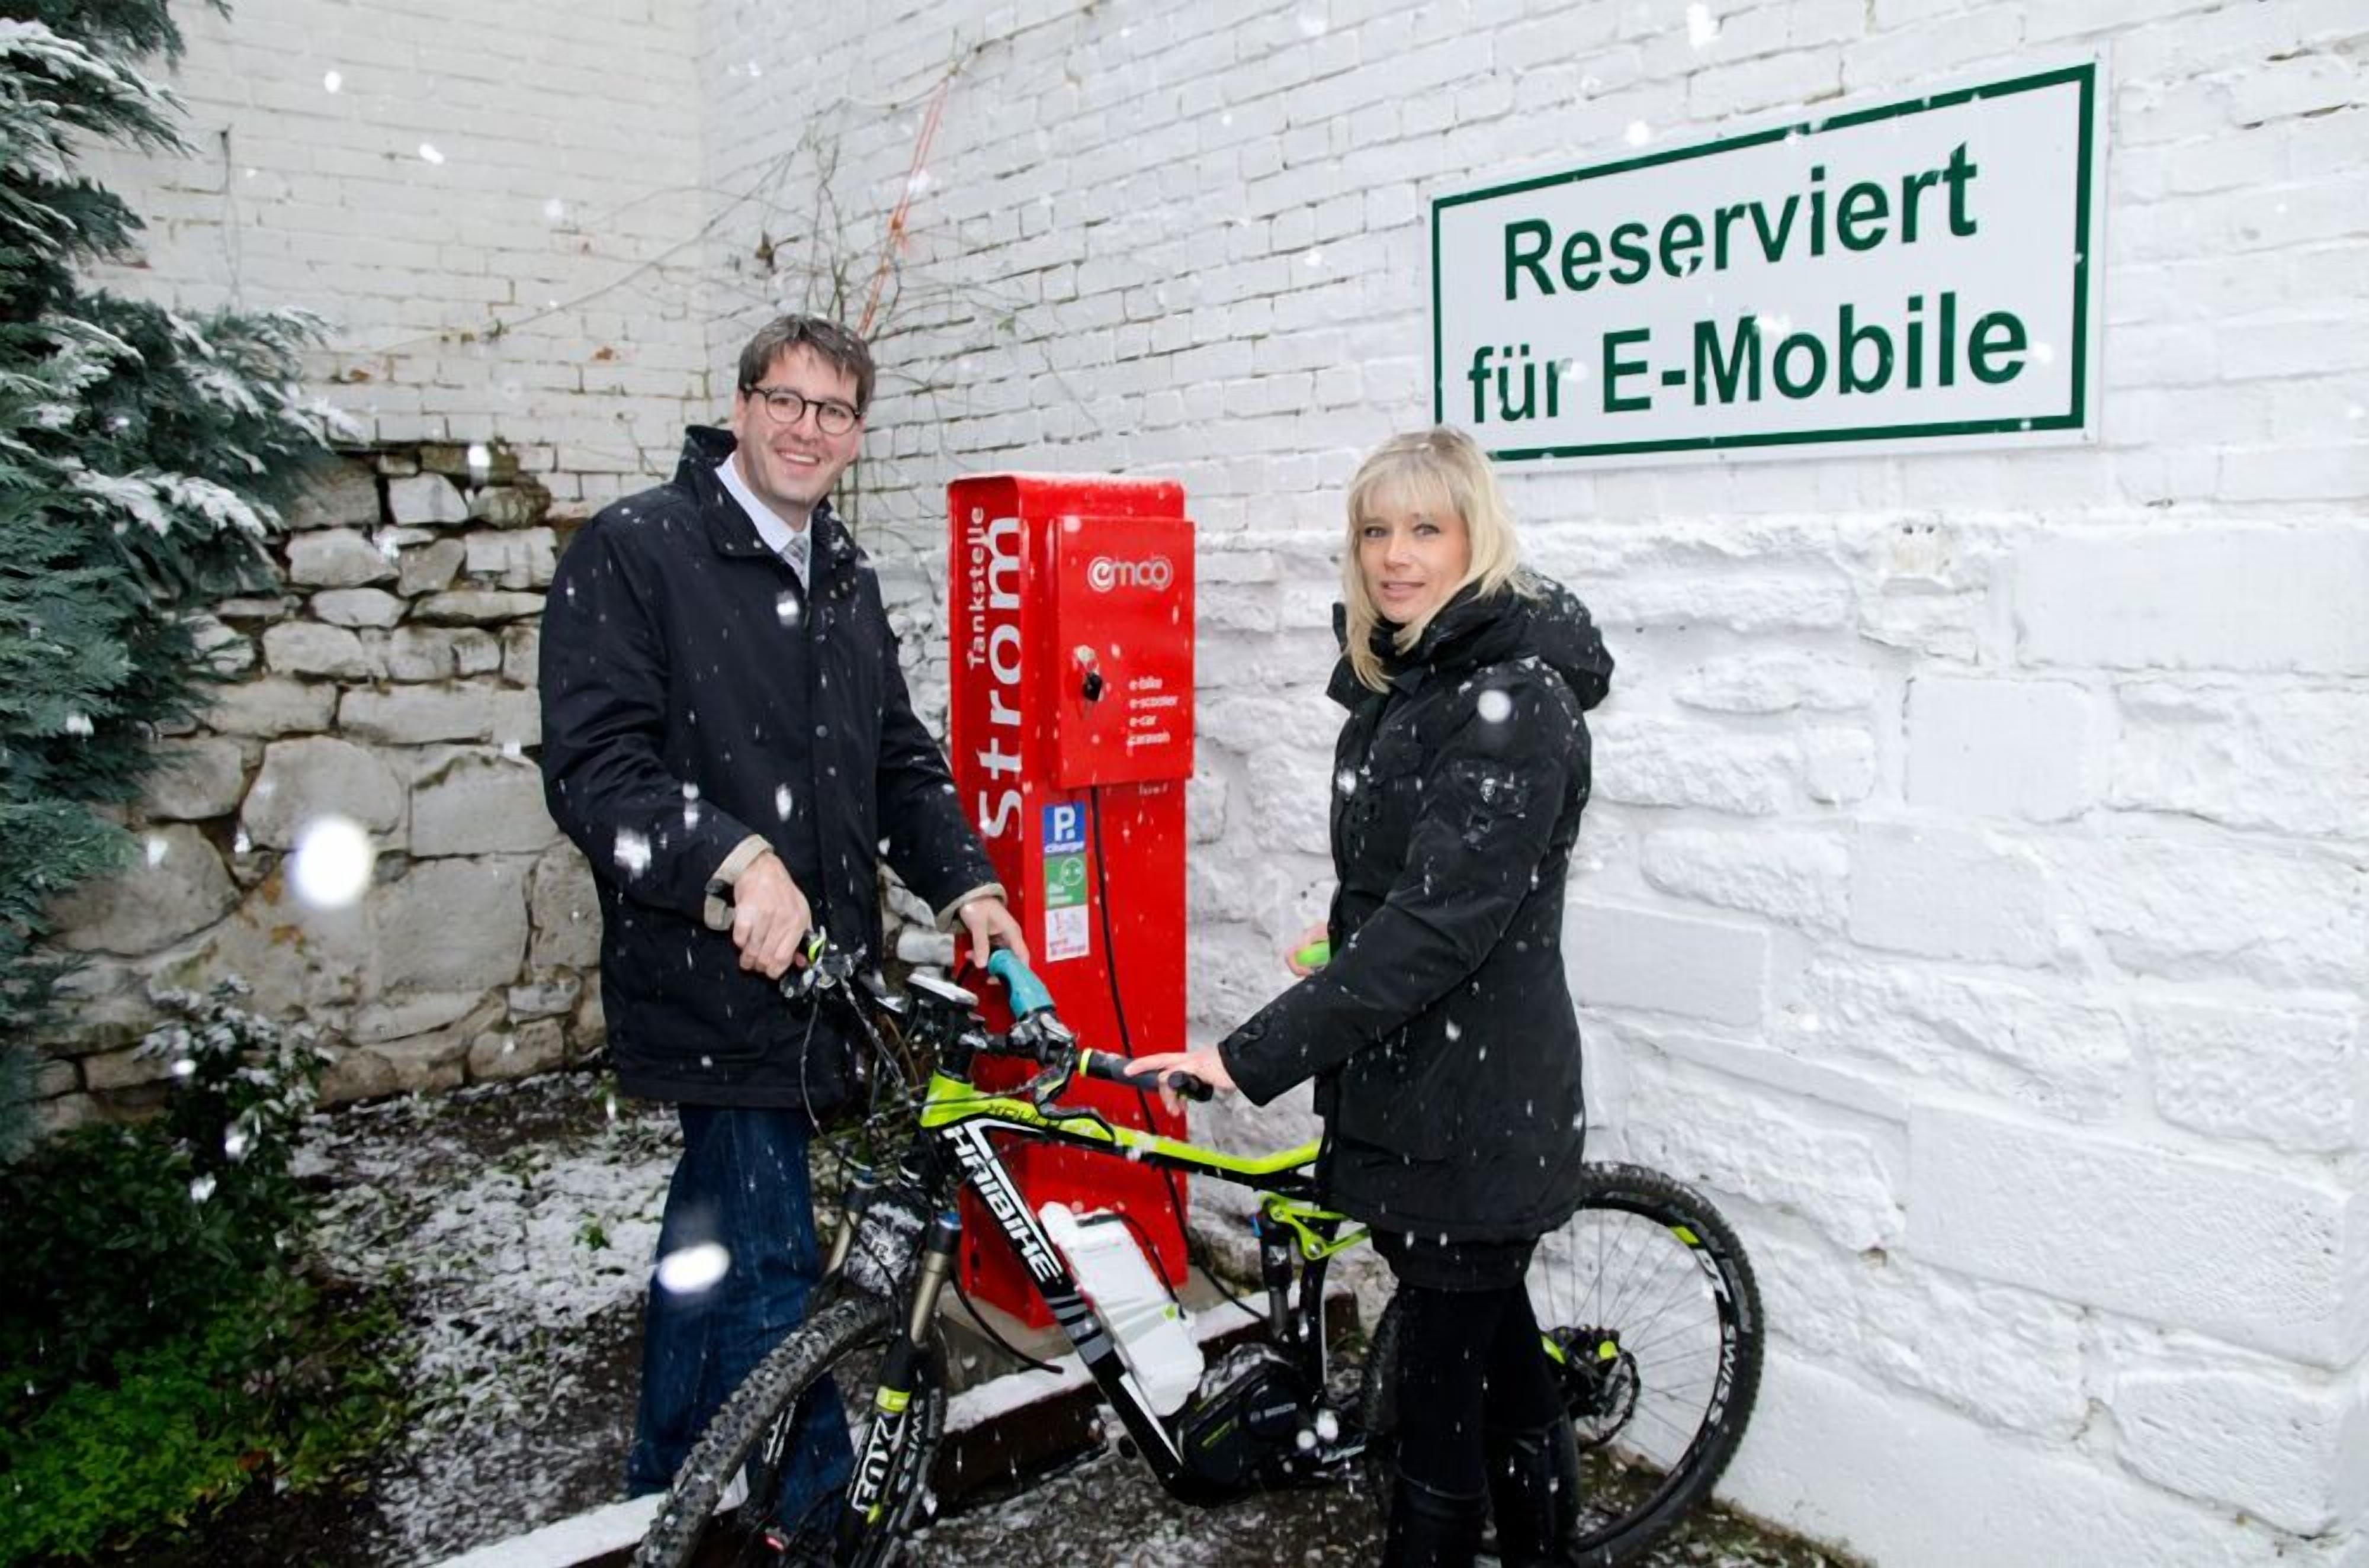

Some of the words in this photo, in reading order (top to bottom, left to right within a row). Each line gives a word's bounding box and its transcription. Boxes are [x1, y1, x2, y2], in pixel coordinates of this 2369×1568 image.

[1504, 141, 1978, 301] Reserviert
[1468, 345, 1573, 424] für
[1601, 291, 2028, 414] E-Mobile
[968, 507, 986, 667] Tankstelle
[976, 517, 1023, 842] Strom
[942, 1123, 1059, 1283] HAIBIKE
[1708, 1322, 1737, 1425] SWISS
